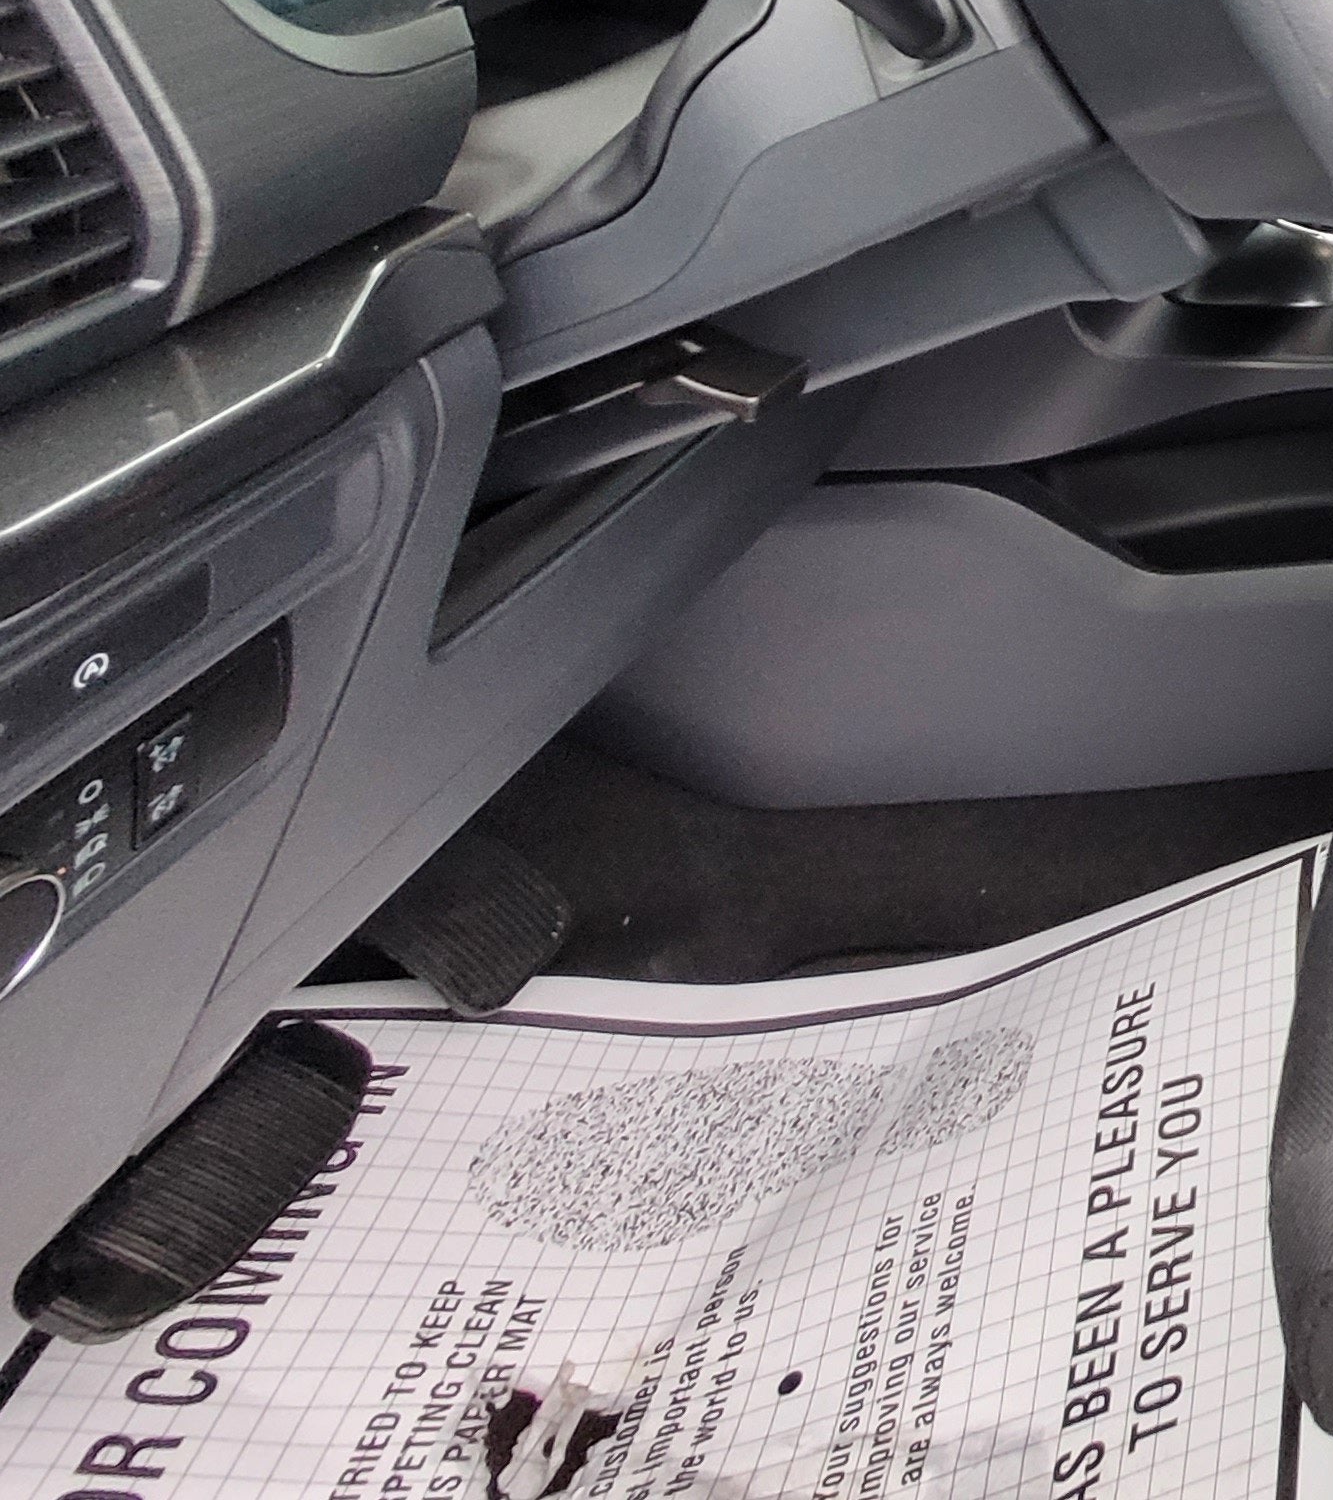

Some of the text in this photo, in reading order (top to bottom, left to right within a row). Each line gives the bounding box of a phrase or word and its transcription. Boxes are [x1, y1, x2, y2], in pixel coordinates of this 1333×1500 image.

[1087, 981, 1157, 1217] PLEASURE
[494, 1295, 548, 1351] MAT
[838, 1257, 894, 1434] suggestions
[874, 1214, 904, 1252] for
[894, 1299, 921, 1345] our
[901, 1183, 978, 1487] are always welcome.
[906, 1191, 943, 1291] service
[1082, 1225, 1130, 1261] A
[1128, 1073, 1204, 1455] TO SERVE YOU
[379, 1280, 514, 1500] PETING CLEAN
[383, 1361, 428, 1401] TO
[409, 1280, 466, 1348] KEEP
[589, 1336, 676, 1498] customer is
[633, 1336, 711, 1475] important
[696, 1245, 749, 1331] person
[663, 1278, 763, 1496] the world to us.
[1062, 1279, 1125, 1429] BEEN
